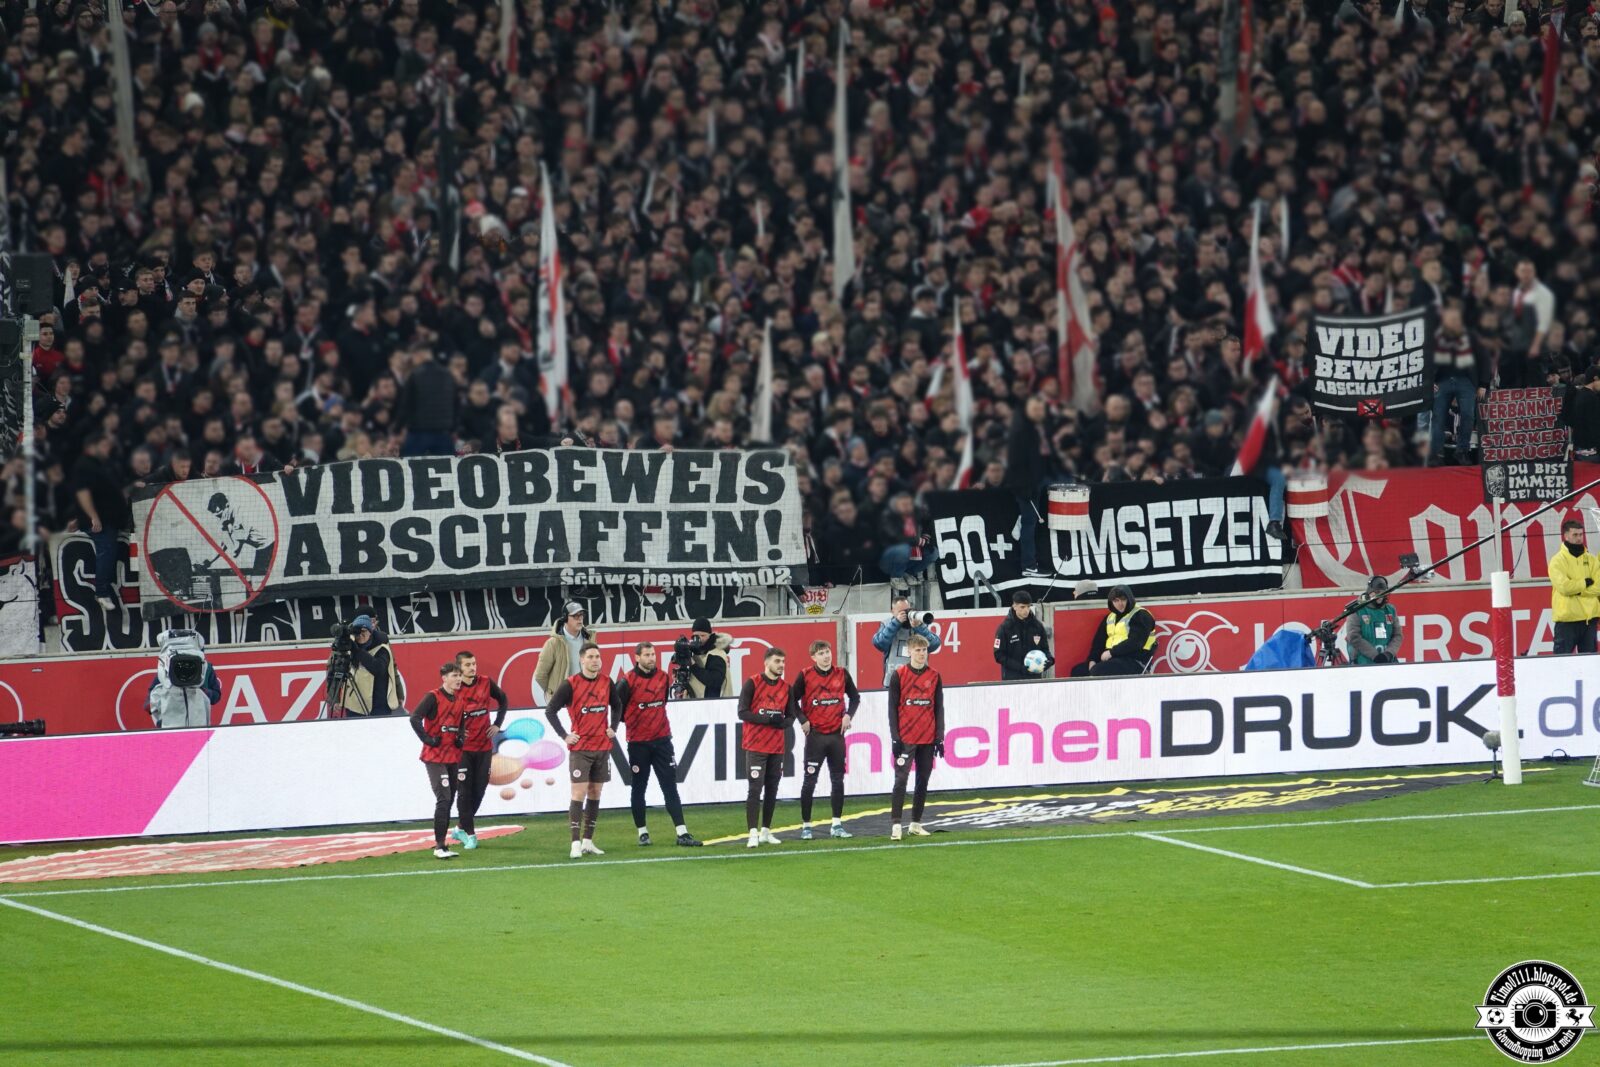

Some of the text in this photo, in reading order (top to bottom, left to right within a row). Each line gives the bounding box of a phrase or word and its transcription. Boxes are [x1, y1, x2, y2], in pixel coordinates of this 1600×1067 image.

[1315, 318, 1425, 358] VIDEO
[1315, 349, 1424, 380] BEWEIS
[1315, 374, 1423, 396] ABSCHAFFEN!
[1488, 387, 1553, 403] JEDER
[1479, 397, 1563, 420] VERBANNTE
[1487, 415, 1557, 433] KEHRT
[1508, 463, 1568, 475] DU BIST
[280, 448, 787, 517] VIDEOBEWEIS
[1508, 475, 1568, 489] IMMER
[284, 509, 784, 577] ABSCHAFFEN!
[934, 496, 1282, 584] 50+ UMSETZEN
